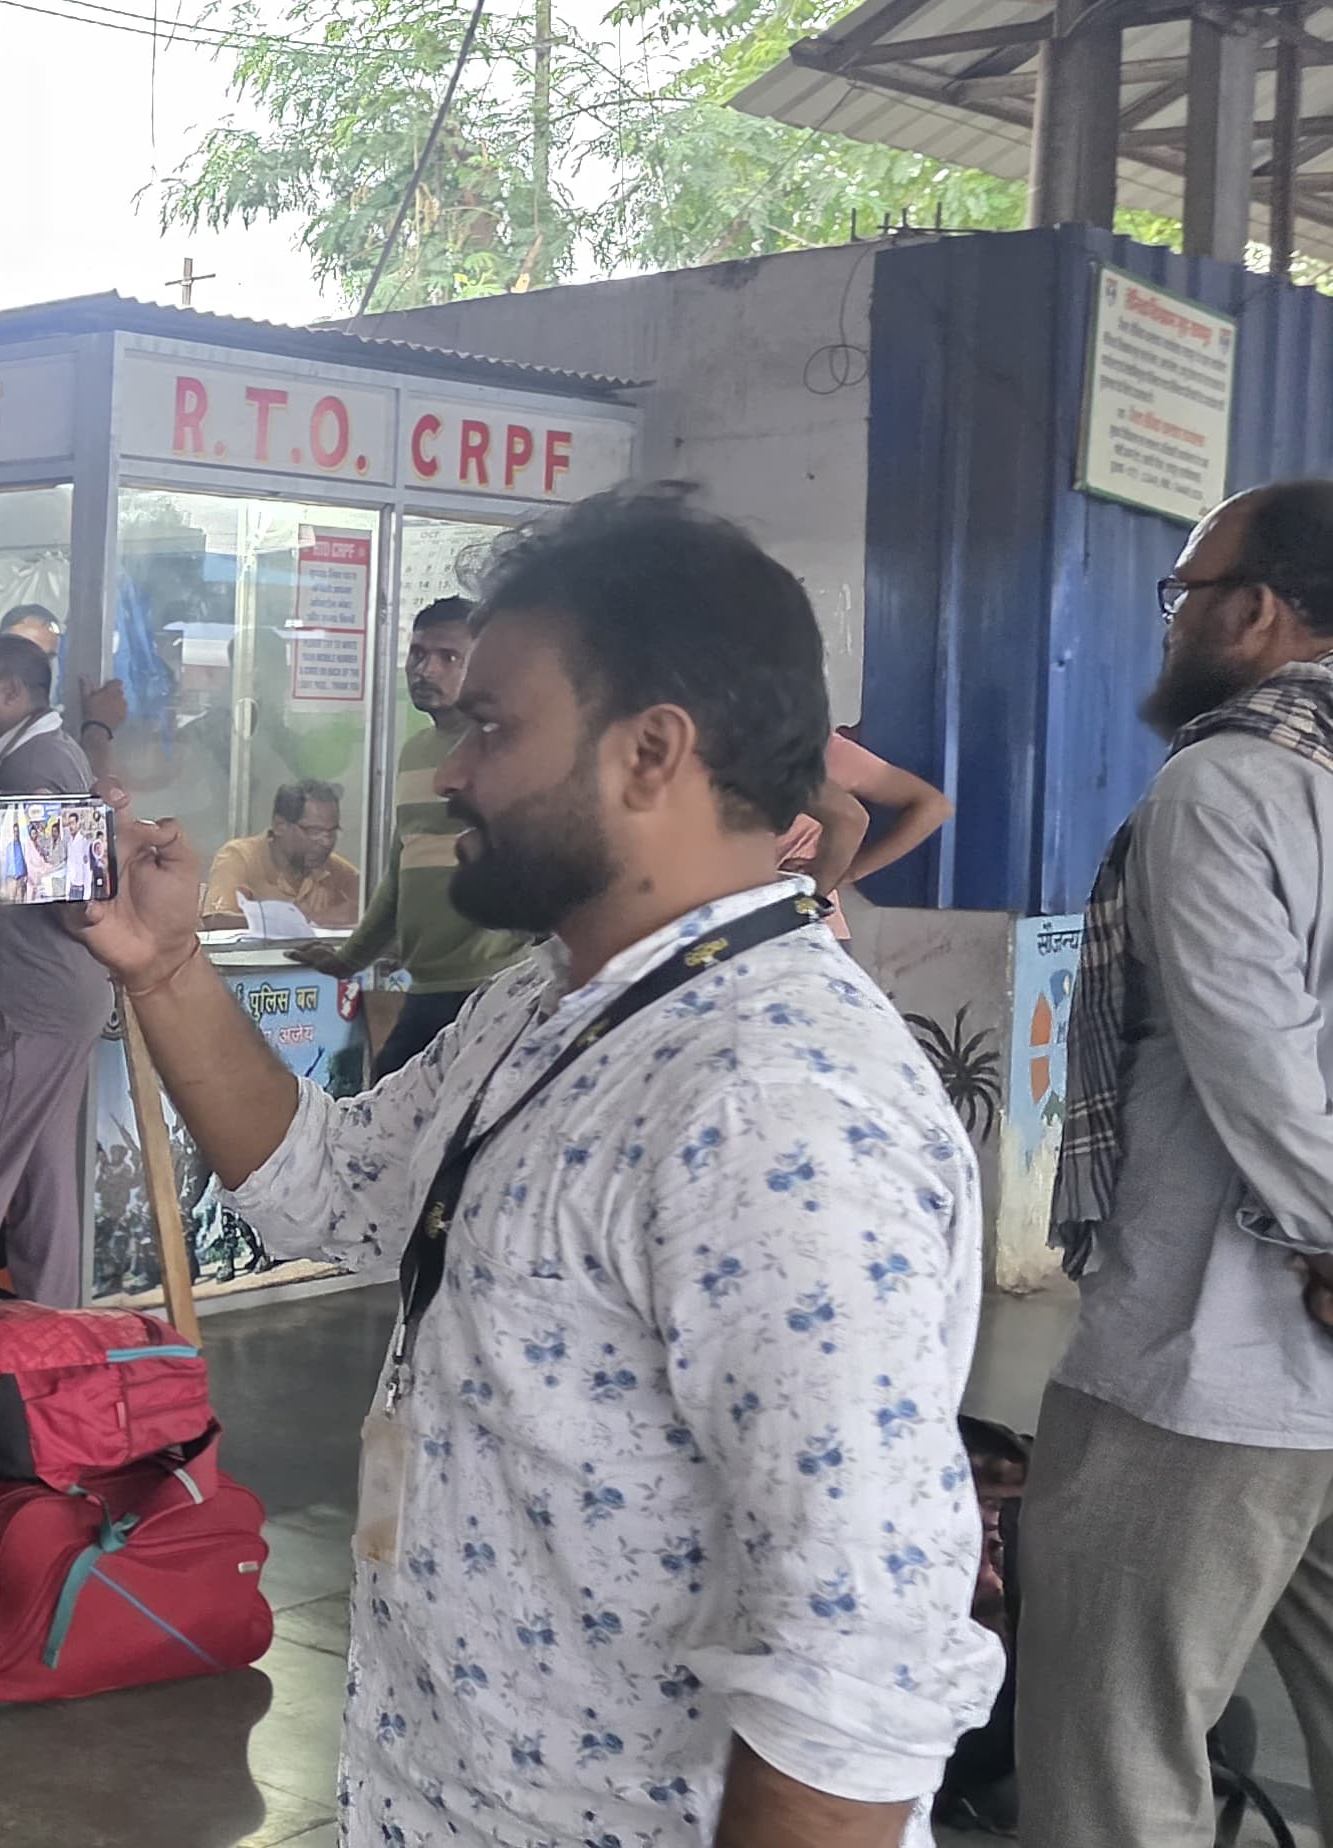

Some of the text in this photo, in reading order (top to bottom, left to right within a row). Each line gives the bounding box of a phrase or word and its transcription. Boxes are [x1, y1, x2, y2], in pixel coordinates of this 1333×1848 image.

[172, 376, 571, 493] R.T.O. CRPF
[249, 983, 289, 1021] पुलिस
